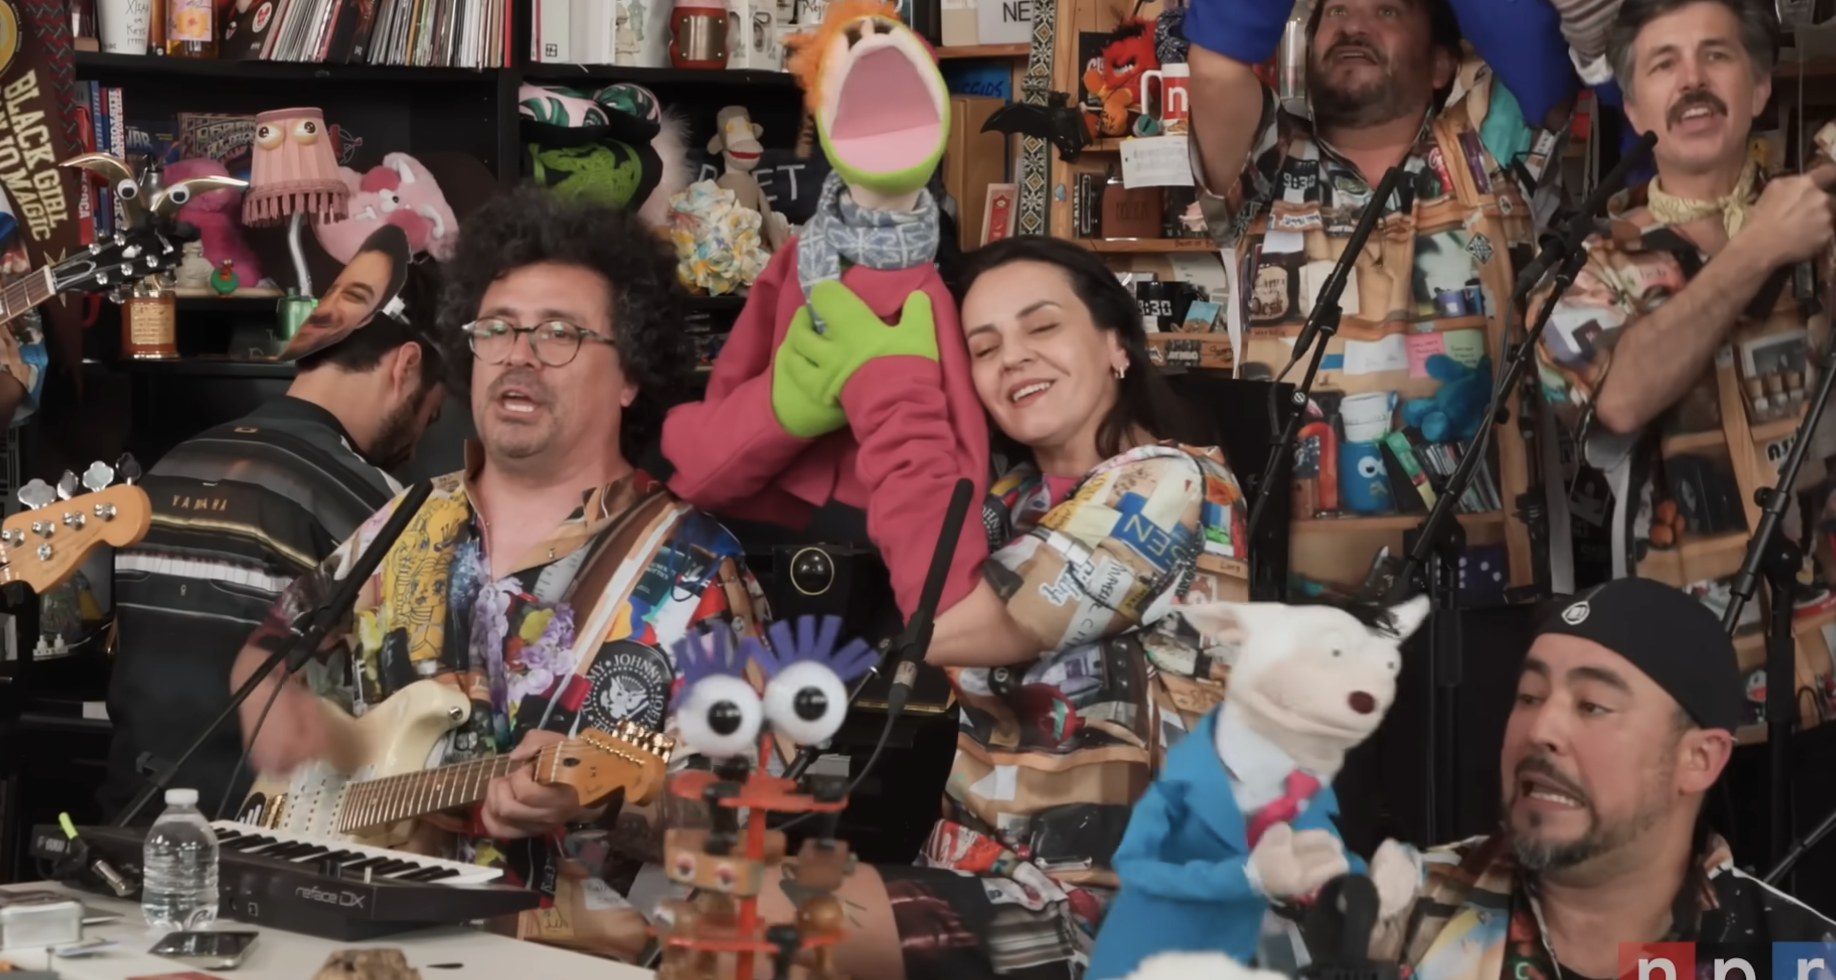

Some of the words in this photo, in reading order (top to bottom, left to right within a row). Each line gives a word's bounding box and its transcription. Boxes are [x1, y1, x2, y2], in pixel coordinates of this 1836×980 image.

[1003, 0, 1034, 23] NE
[4, 69, 55, 170] BLACK
[33, 168, 68, 229] GIRL
[1283, 173, 1316, 190] 9:30
[1, 166, 51, 241] MAGIC
[172, 494, 227, 511] YAMAHA
[614, 653, 662, 685] JOHNNY
[581, 661, 606, 716] TOMY
[650, 694, 664, 728] JOEY
[295, 886, 338, 904] reface
[339, 890, 366, 909] DX
